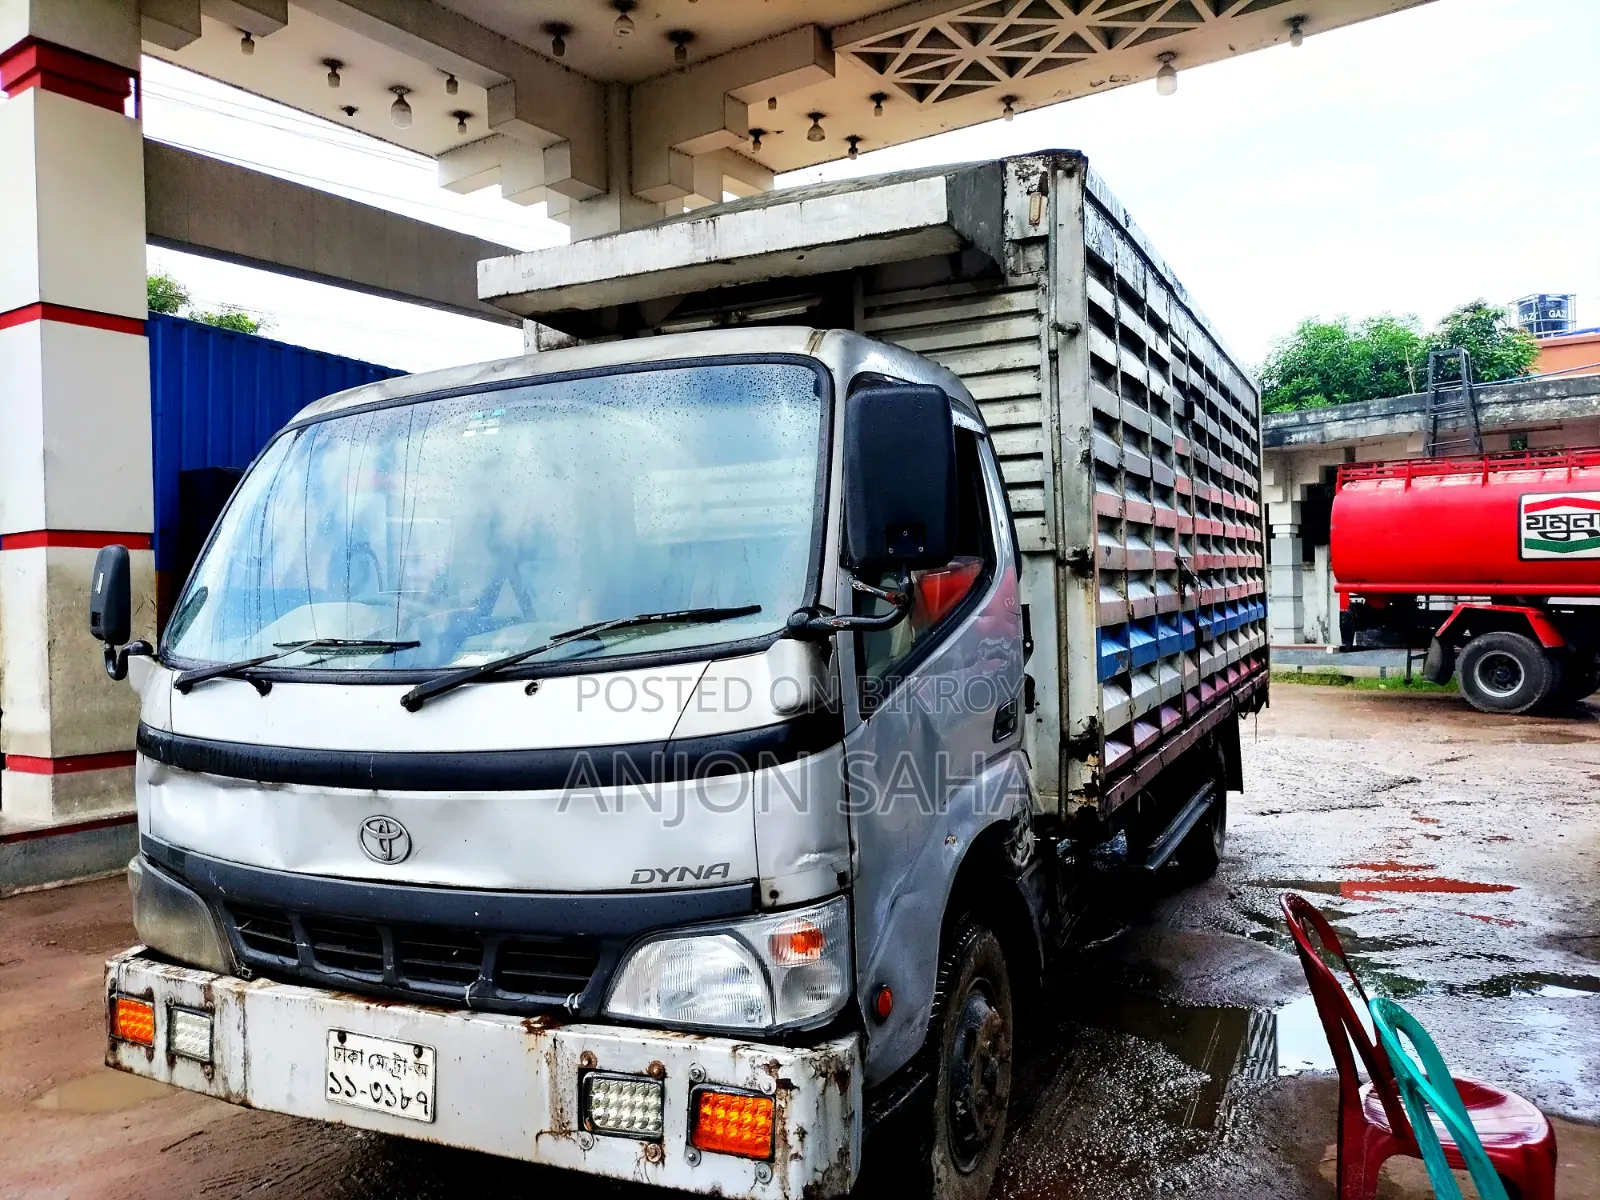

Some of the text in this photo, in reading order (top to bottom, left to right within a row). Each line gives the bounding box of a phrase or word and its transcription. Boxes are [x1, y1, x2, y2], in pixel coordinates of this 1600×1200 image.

[1526, 513, 1600, 541] যমুন
[630, 862, 731, 885] DYNA
[333, 1045, 364, 1066] ঢাকা
